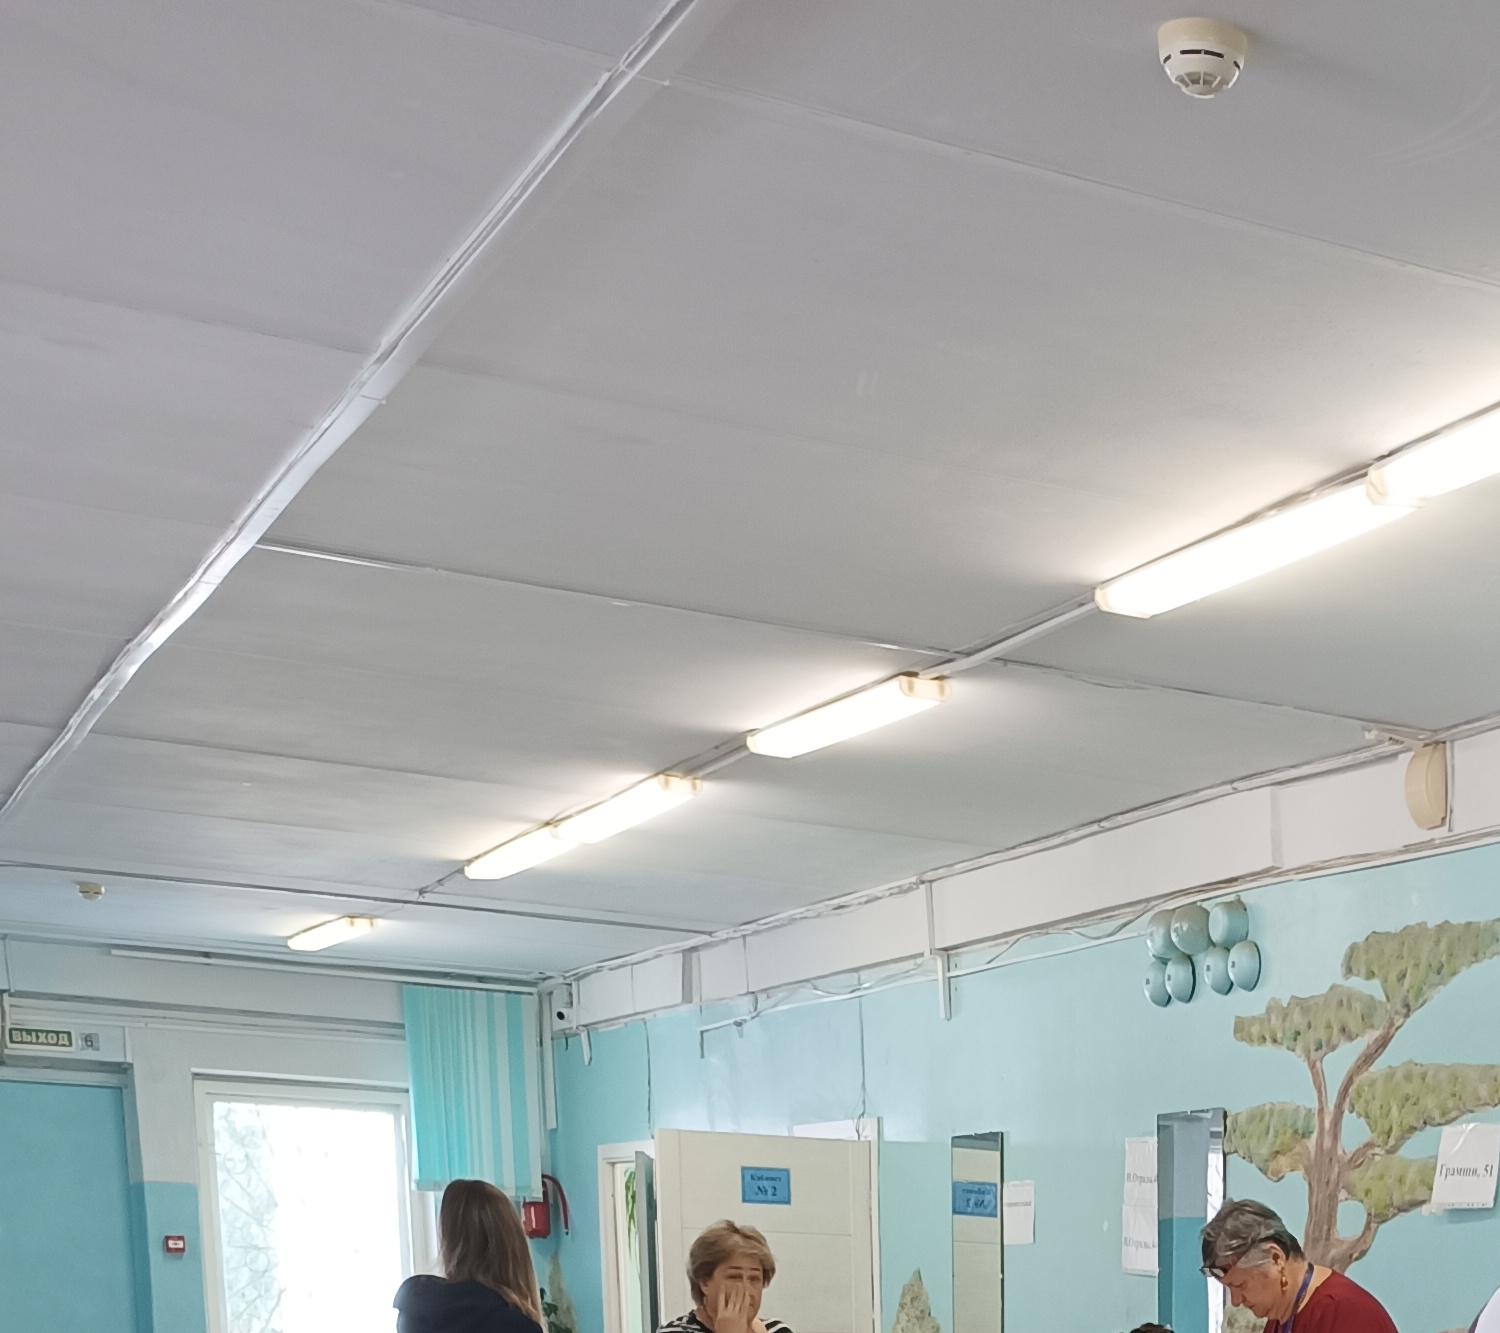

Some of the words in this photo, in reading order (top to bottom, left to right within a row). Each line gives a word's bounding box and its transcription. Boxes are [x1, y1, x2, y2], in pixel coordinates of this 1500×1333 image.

[11, 1029, 70, 1046] ВЫХОД
[84, 1033, 94, 1048] 6
[1483, 1163, 1494, 1178] 51
[771, 1185, 778, 1197] 2
